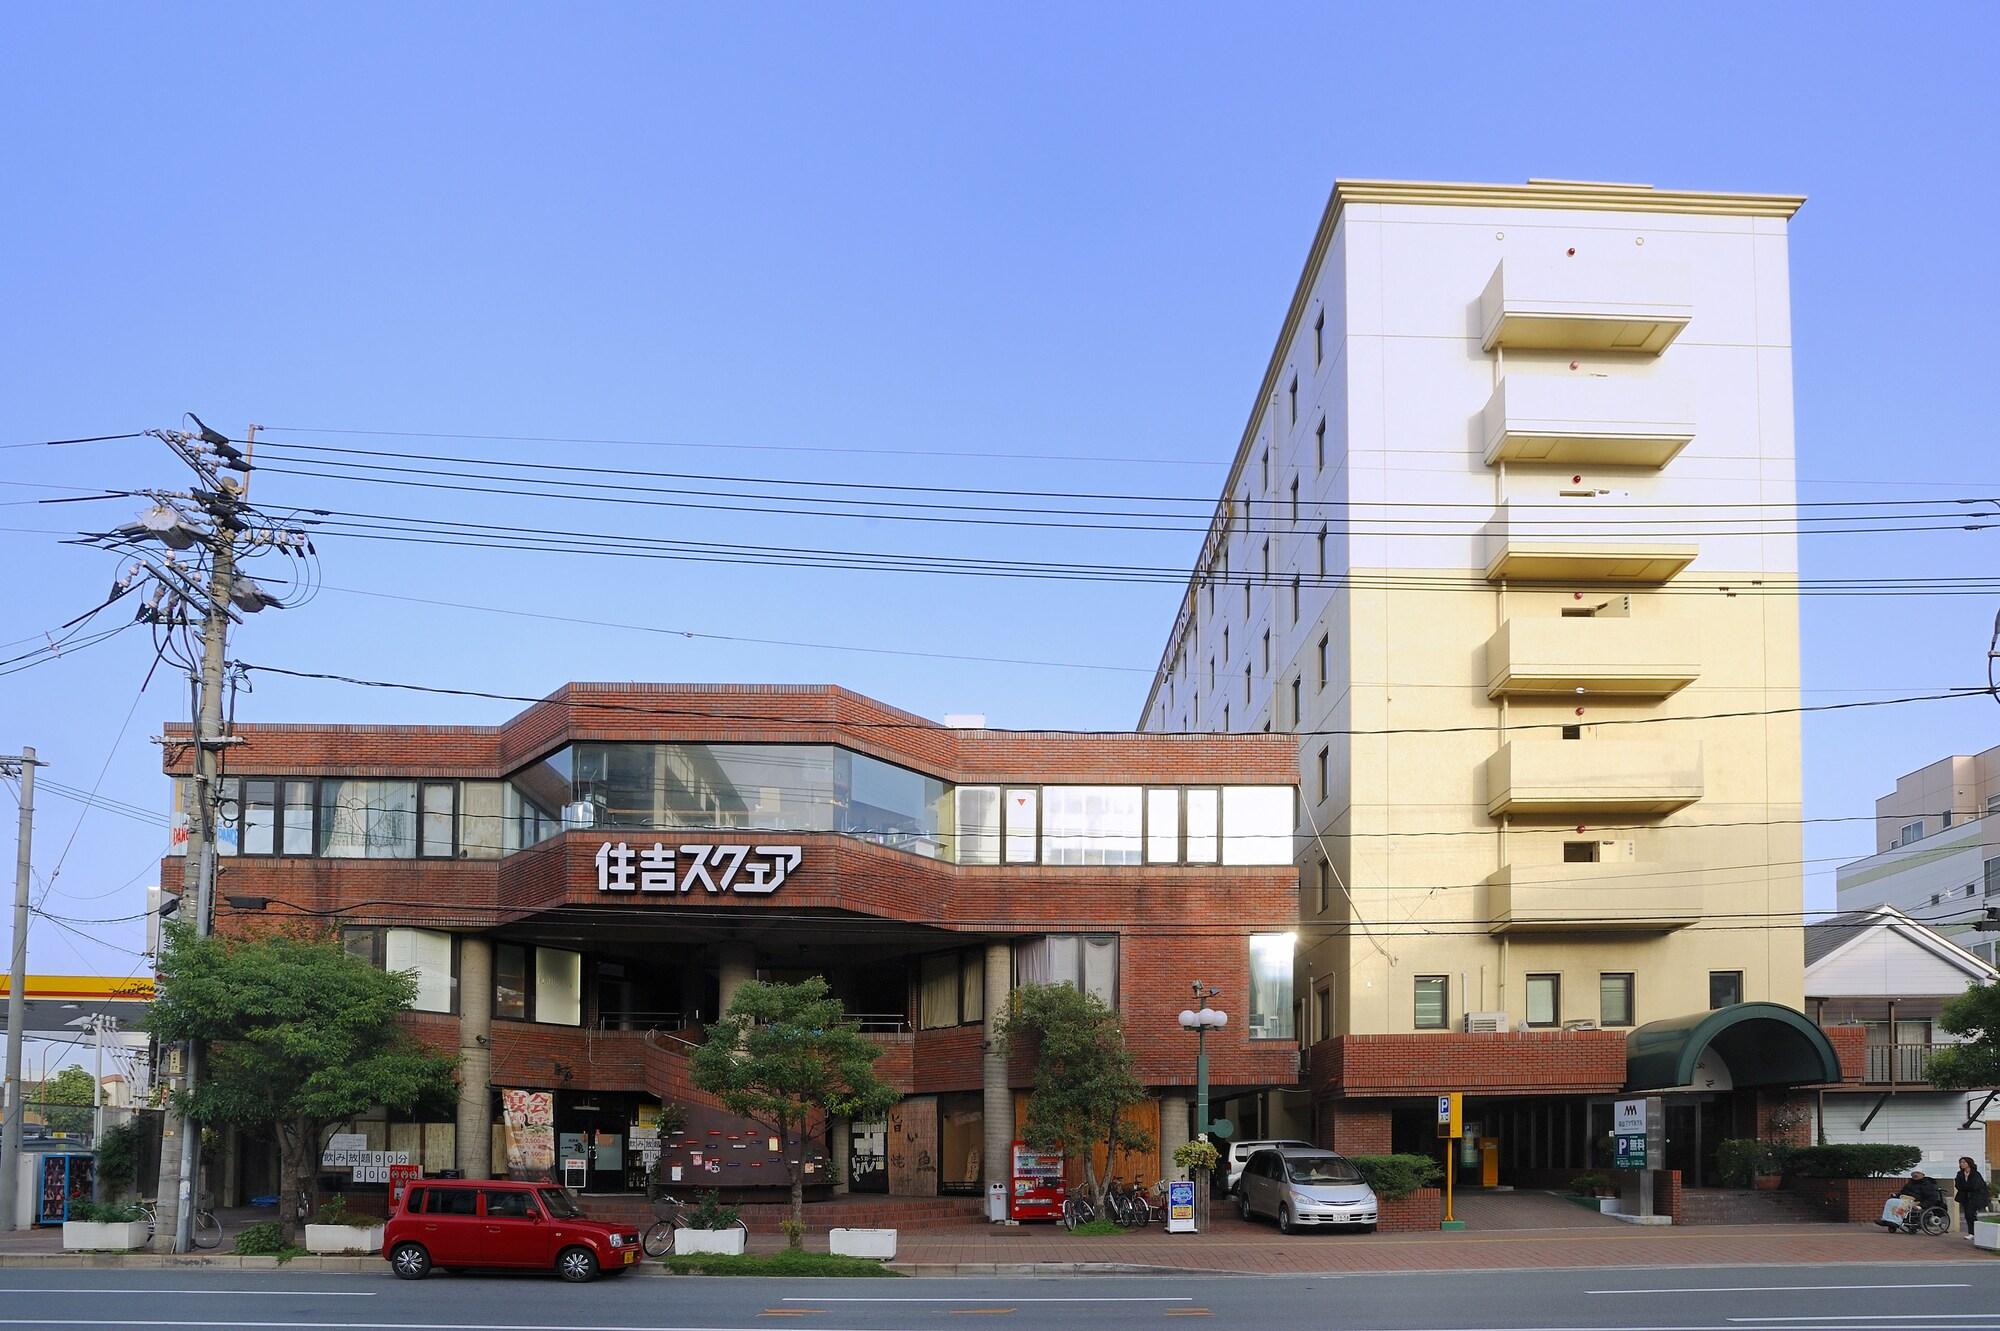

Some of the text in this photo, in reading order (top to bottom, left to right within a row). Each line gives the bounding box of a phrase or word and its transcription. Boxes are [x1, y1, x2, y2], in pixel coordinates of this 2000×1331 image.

[505, 1092, 549, 1115] 宴会
[1441, 1098, 1448, 1112] P
[1618, 1138, 1627, 1155] P
[1629, 1138, 1645, 1151] 無料
[323, 1151, 408, 1164] 飲み放題90分
